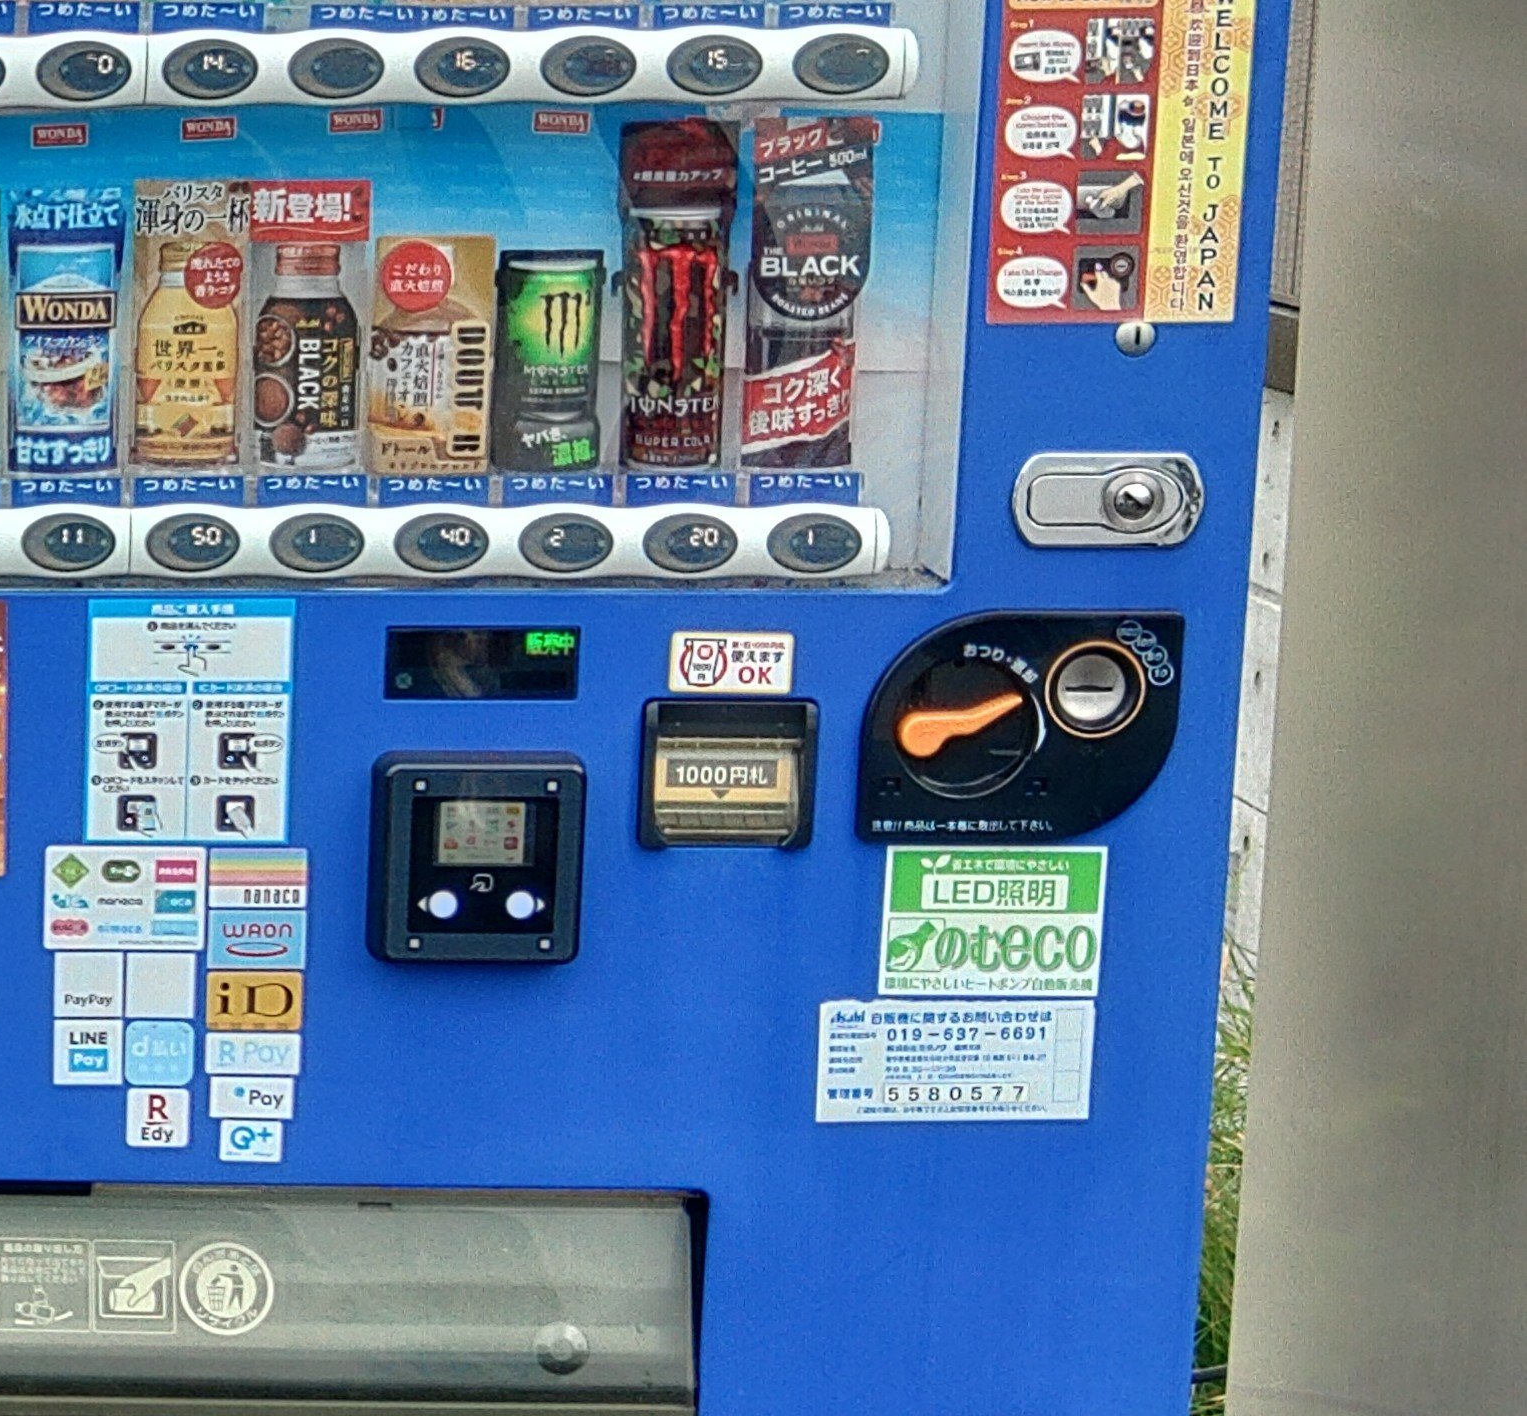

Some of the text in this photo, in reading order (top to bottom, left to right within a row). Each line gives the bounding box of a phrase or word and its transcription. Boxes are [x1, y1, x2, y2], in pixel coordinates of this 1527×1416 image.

[253, 188, 352, 225] 新登場!
[760, 254, 861, 278] BLACK
[737, 665, 772, 685] OK
[675, 765, 768, 786] 1000円札
[244, 888, 301, 903] nanaco
[933, 880, 1056, 906] LED照明
[222, 922, 293, 938] WAON
[64, 994, 113, 1007] PayPay
[216, 982, 293, 1017] iD
[69, 1032, 108, 1045] LINE
[72, 1053, 104, 1069] Pay
[141, 1127, 174, 1142] Edy
